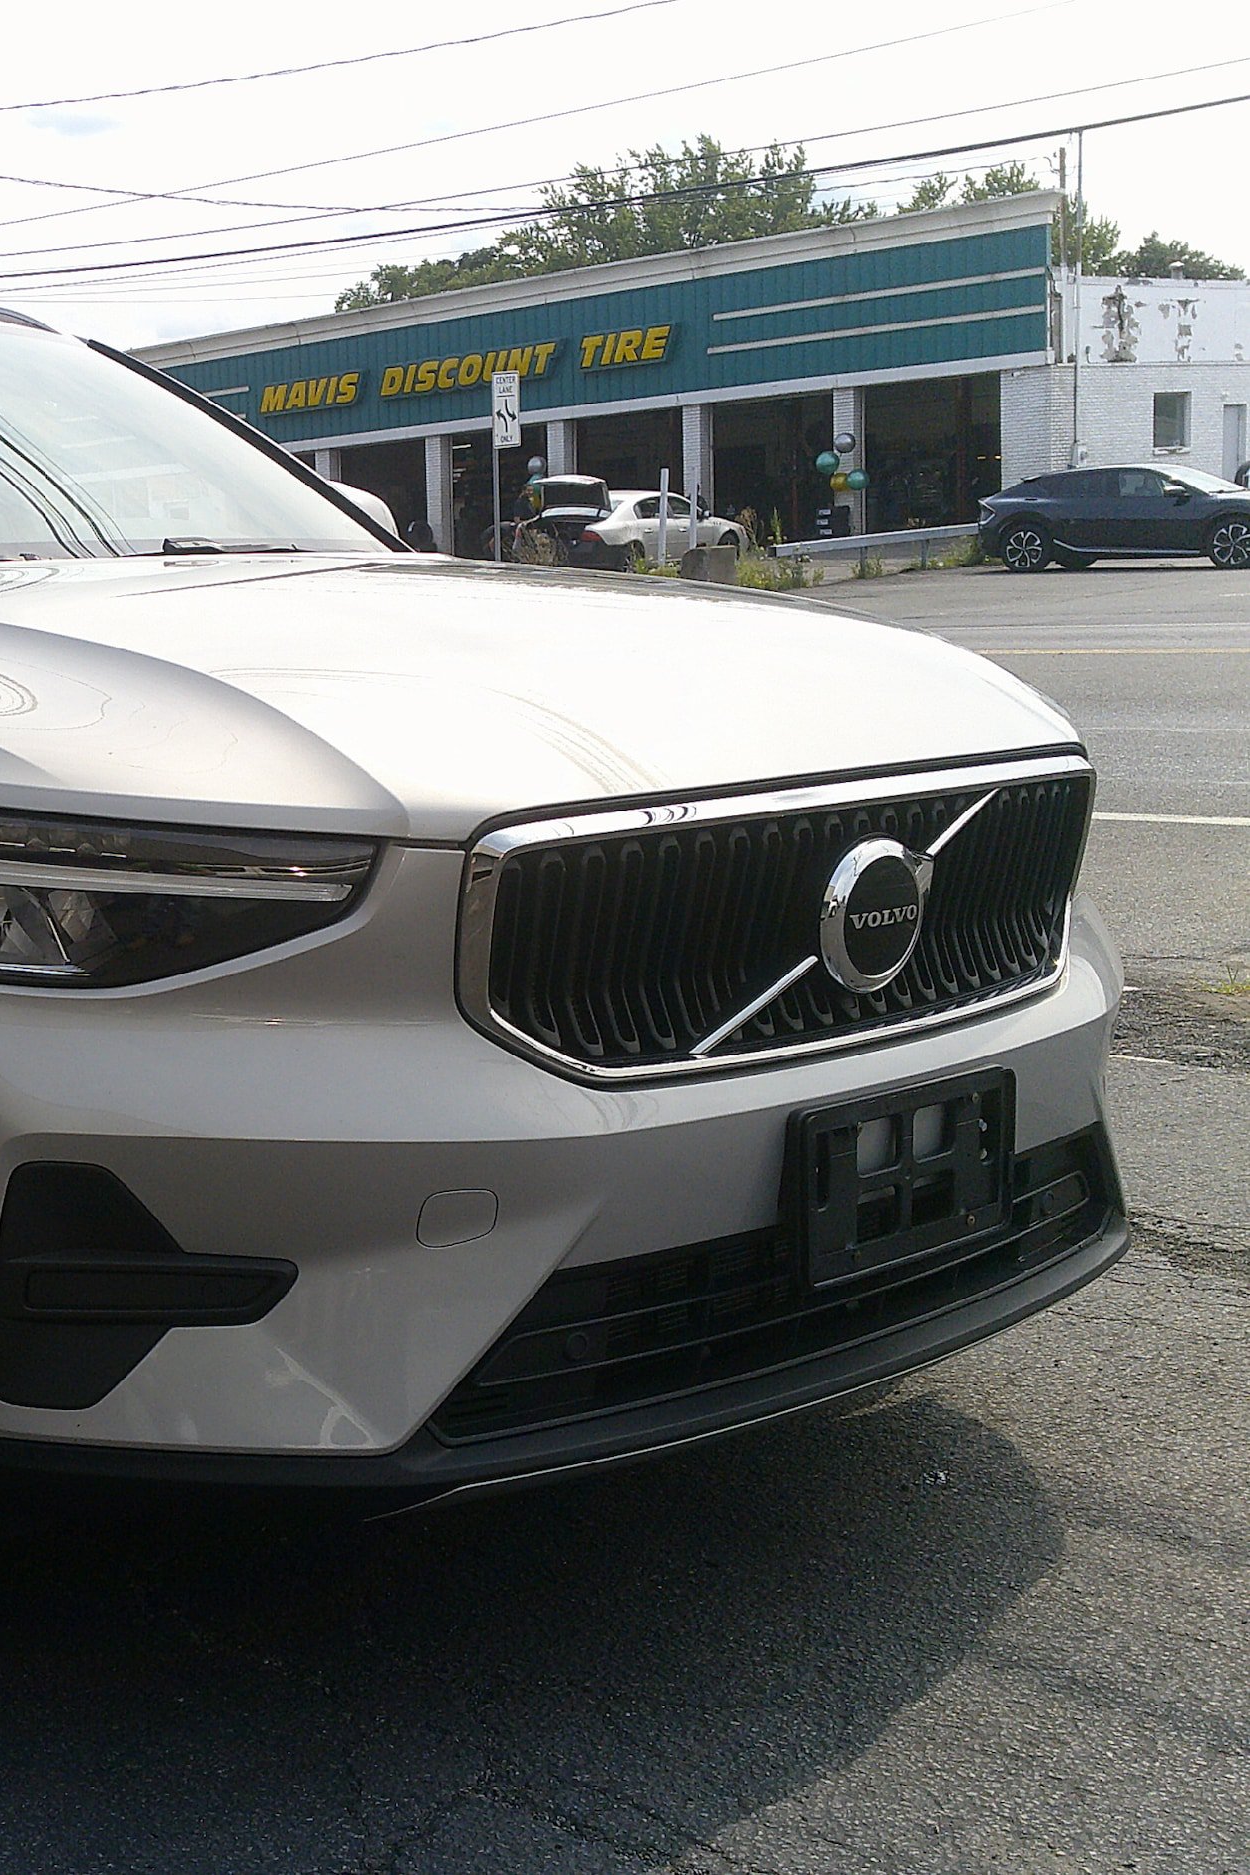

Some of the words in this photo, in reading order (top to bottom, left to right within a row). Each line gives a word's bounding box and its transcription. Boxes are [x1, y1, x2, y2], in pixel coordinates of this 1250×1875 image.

[260, 372, 359, 413] MAVIS
[380, 342, 556, 396] DISCOUNT
[580, 325, 671, 369] TIRE
[496, 376, 516, 385] CENTER
[499, 386, 513, 394] LANE
[500, 435, 513, 443] ONLY
[849, 904, 918, 930] VOLVO
